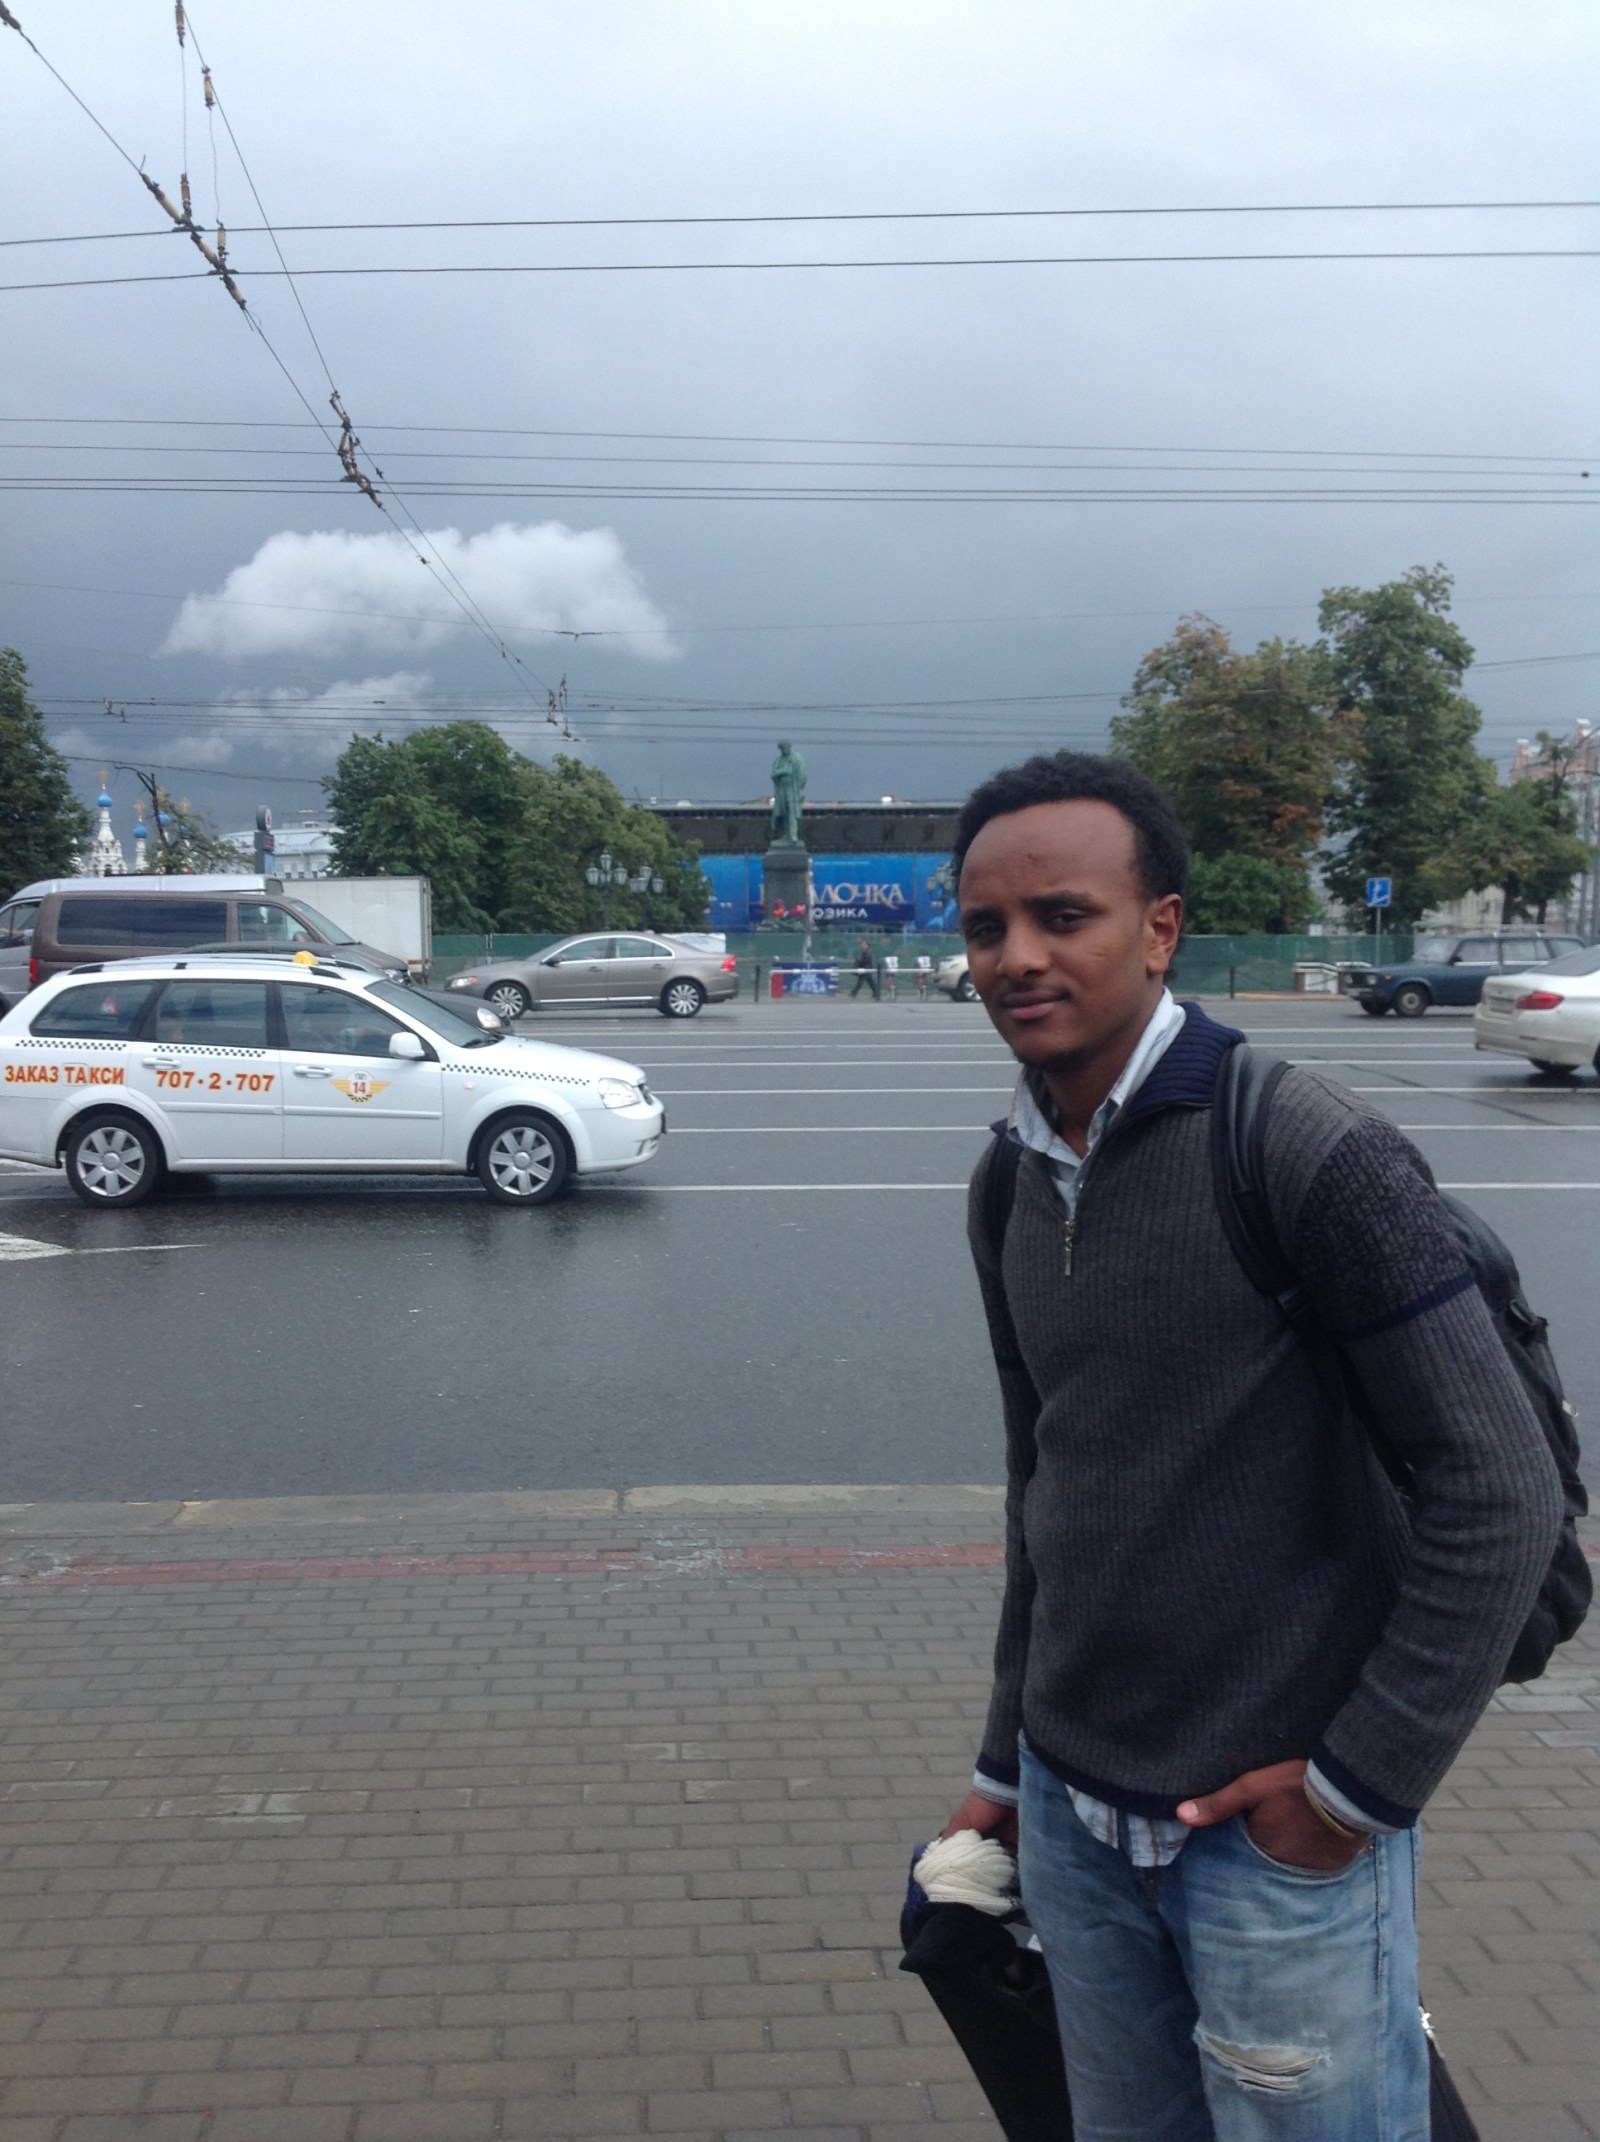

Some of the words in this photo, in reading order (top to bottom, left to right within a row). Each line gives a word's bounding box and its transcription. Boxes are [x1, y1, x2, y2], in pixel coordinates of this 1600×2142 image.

[5, 1065, 59, 1083] ЗАКАЗ
[64, 1066, 124, 1085] ТАКСИ
[353, 1081, 366, 1094] 14
